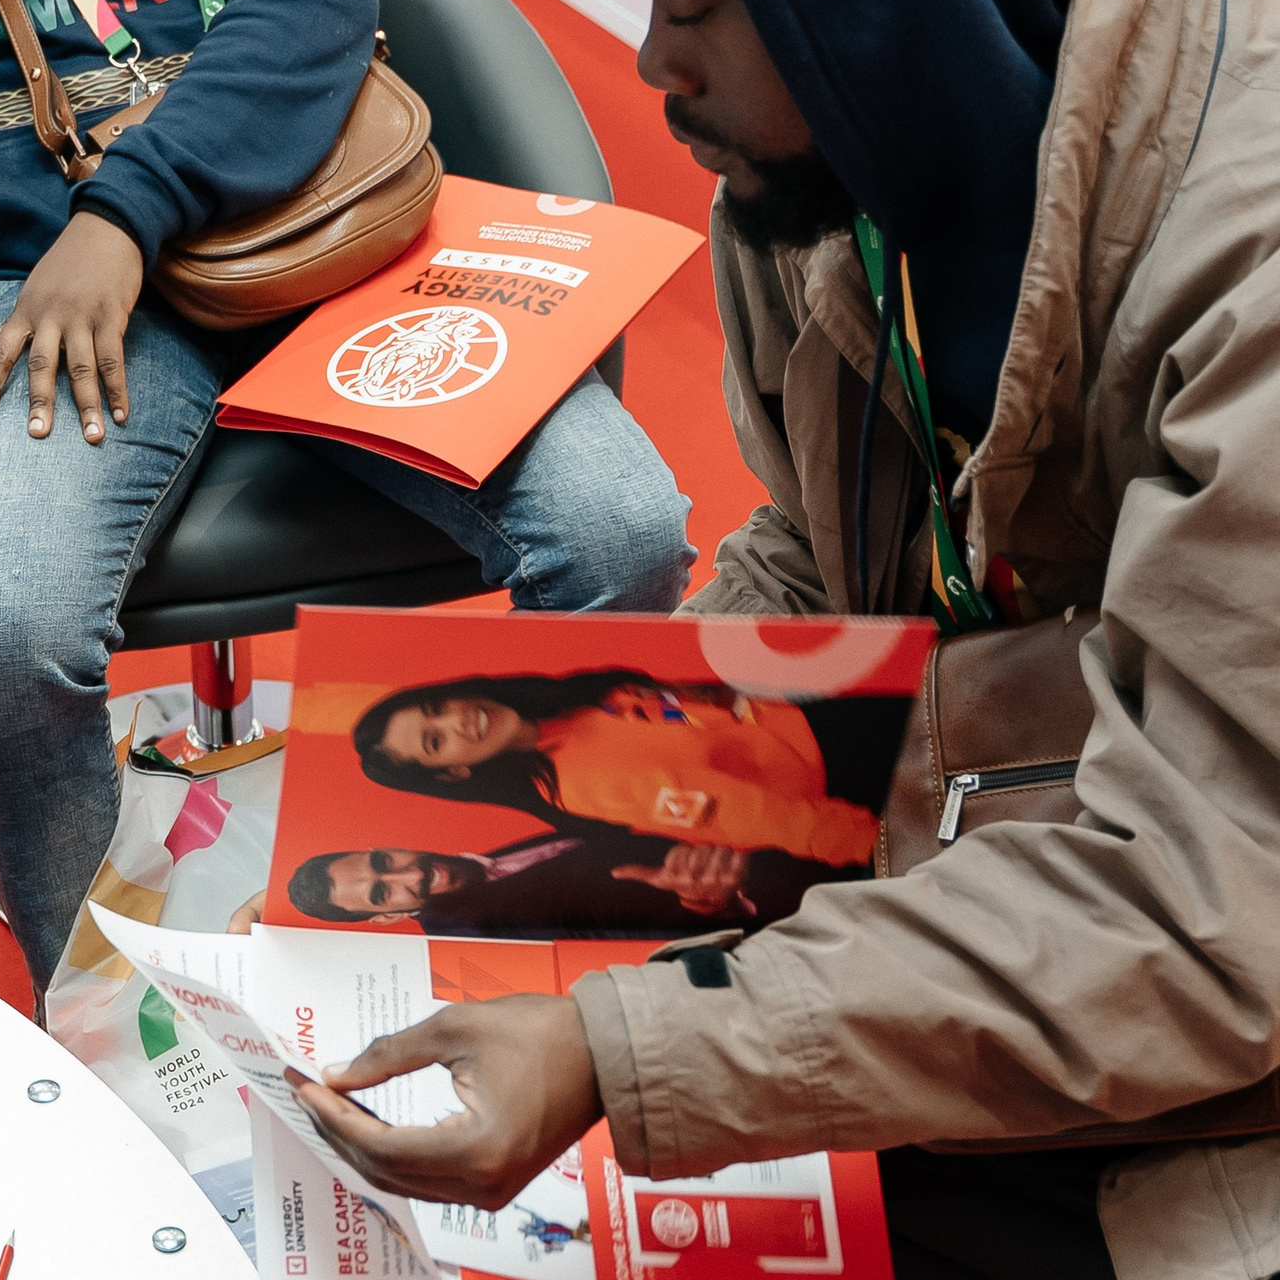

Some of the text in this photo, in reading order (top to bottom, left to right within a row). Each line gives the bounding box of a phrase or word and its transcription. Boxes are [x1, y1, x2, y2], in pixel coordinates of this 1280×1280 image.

[478, 224, 540, 239] EDUCATION
[478, 232, 582, 252] UNITING COUNTRIES
[538, 232, 592, 248] THROUGH
[441, 253, 578, 281] EMBASSY
[400, 280, 558, 316] SYNERGY
[417, 267, 568, 300] UNIVERSITY
[154, 1048, 201, 1079] WORLD
[160, 1062, 206, 1091] YOUTH
[166, 1069, 229, 1103] FESTIVAL
[170, 1096, 205, 1113] 2024
[282, 1196, 295, 1252] SYNERGY
[292, 1180, 306, 1253] UNIVERSITY
[337, 1236, 351, 1249] A
[353, 1239, 369, 1275] FOR
[338, 1252, 352, 1275] BE
